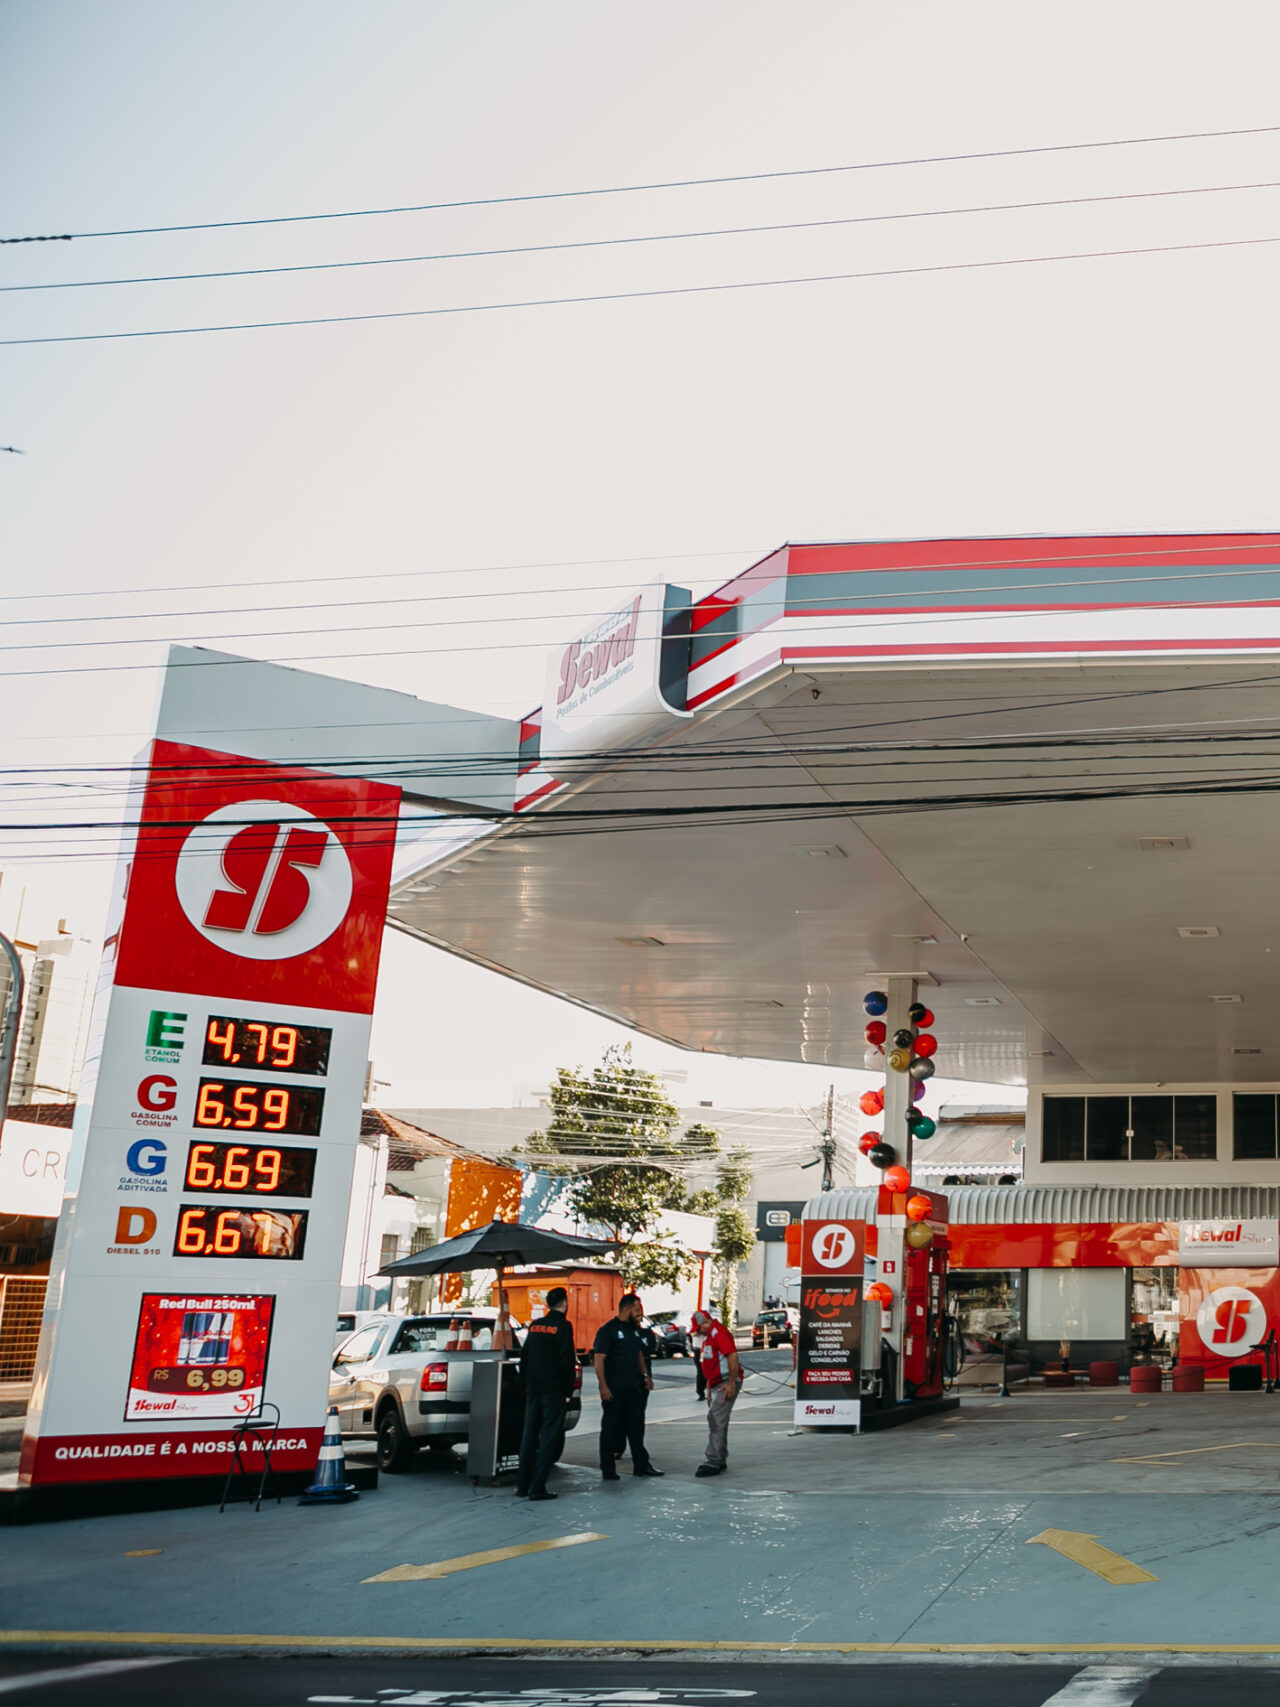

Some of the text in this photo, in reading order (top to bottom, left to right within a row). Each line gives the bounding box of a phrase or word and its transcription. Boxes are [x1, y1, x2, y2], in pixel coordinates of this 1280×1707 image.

[557, 594, 641, 704] Sewal
[145, 1010, 188, 1049] E
[145, 1049, 181, 1057] ETANOL
[207, 1020, 297, 1067] 4,79
[145, 1056, 180, 1064] COMUM
[137, 1074, 177, 1112] G
[131, 1112, 177, 1121] GASOLINA
[197, 1083, 289, 1129] 6,59
[136, 1119, 171, 1127] COMUM
[127, 1139, 167, 1176] G
[187, 1145, 281, 1191] 6,69
[117, 1184, 167, 1192] ADITIVADA
[120, 1177, 167, 1185] GASOLINA
[115, 1206, 157, 1244] D
[178, 1210, 273, 1254] 6,67
[160, 1300, 255, 1310] Red Bull 250ml
[187, 1369, 244, 1391] 6,99
[134, 1399, 176, 1411] Sewal
[805, 1405, 835, 1415] Sewal
[55, 1438, 308, 1459] QUALIDADE É A NOSSA MARCA
